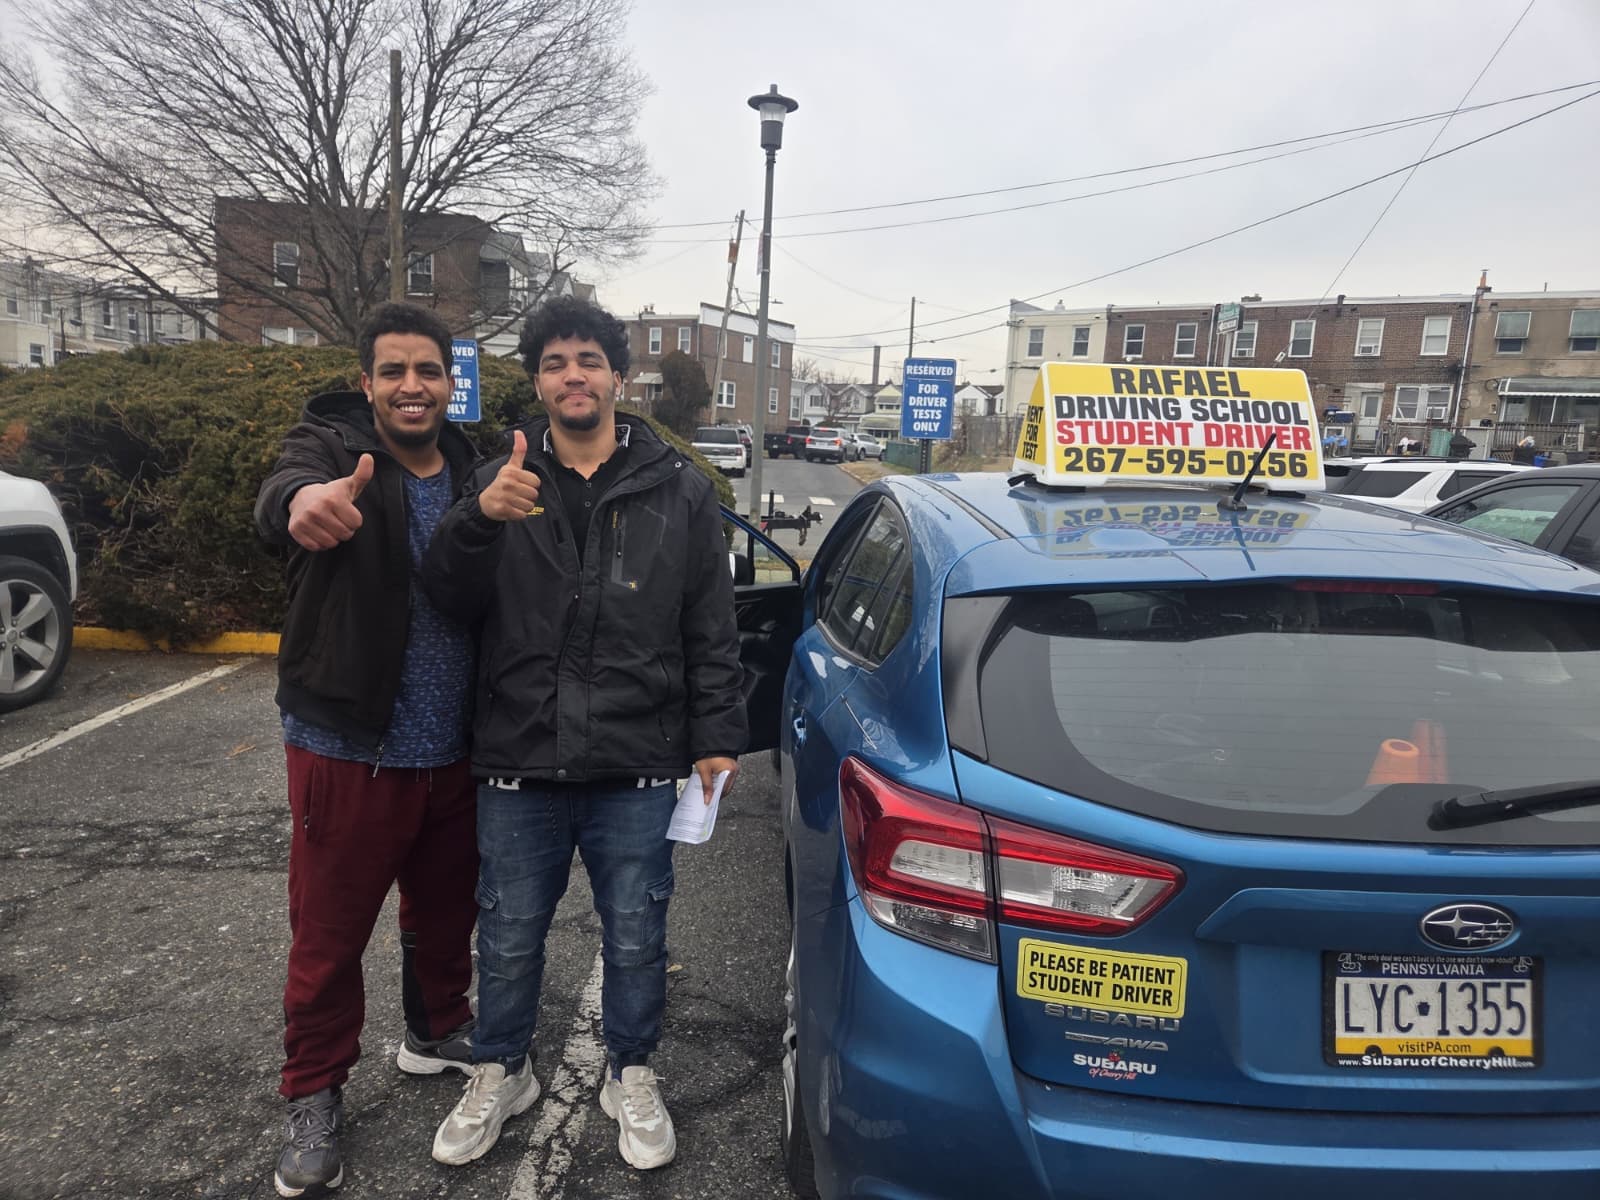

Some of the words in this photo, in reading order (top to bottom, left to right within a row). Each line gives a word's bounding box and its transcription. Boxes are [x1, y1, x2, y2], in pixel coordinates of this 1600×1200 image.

[906, 365, 953, 376] RESERVED
[918, 383, 939, 394] FOR
[1111, 368, 1250, 398] RAFAEL
[908, 396, 947, 407] DRIVER
[1055, 395, 1181, 422] DRIVING
[1191, 399, 1309, 426] SCHOOL
[912, 408, 942, 419] TESTS
[913, 421, 940, 432] ONLY
[1025, 423, 1039, 442] FOR
[1056, 420, 1193, 447] STUDENT
[1204, 423, 1313, 451] DRIVER
[1022, 441, 1038, 461] TEST
[1030, 950, 1085, 975] PLEASE
[1089, 959, 1108, 978] BE
[1111, 962, 1176, 986] PATIENT
[1382, 963, 1485, 976] PENNSYLVANIA
[1028, 971, 1103, 998] STUDENT
[1111, 983, 1173, 1007] DRIVER
[1044, 1003, 1180, 1032] SUBARU
[1437, 981, 1526, 1036] 1355
[1104, 1037, 1169, 1051] AWD
[1398, 1041, 1472, 1054] visitPA.com
[1073, 1053, 1156, 1075] SUBARU
[1099, 1068, 1123, 1080] Cherry
[1123, 1071, 1138, 1080] Hill
